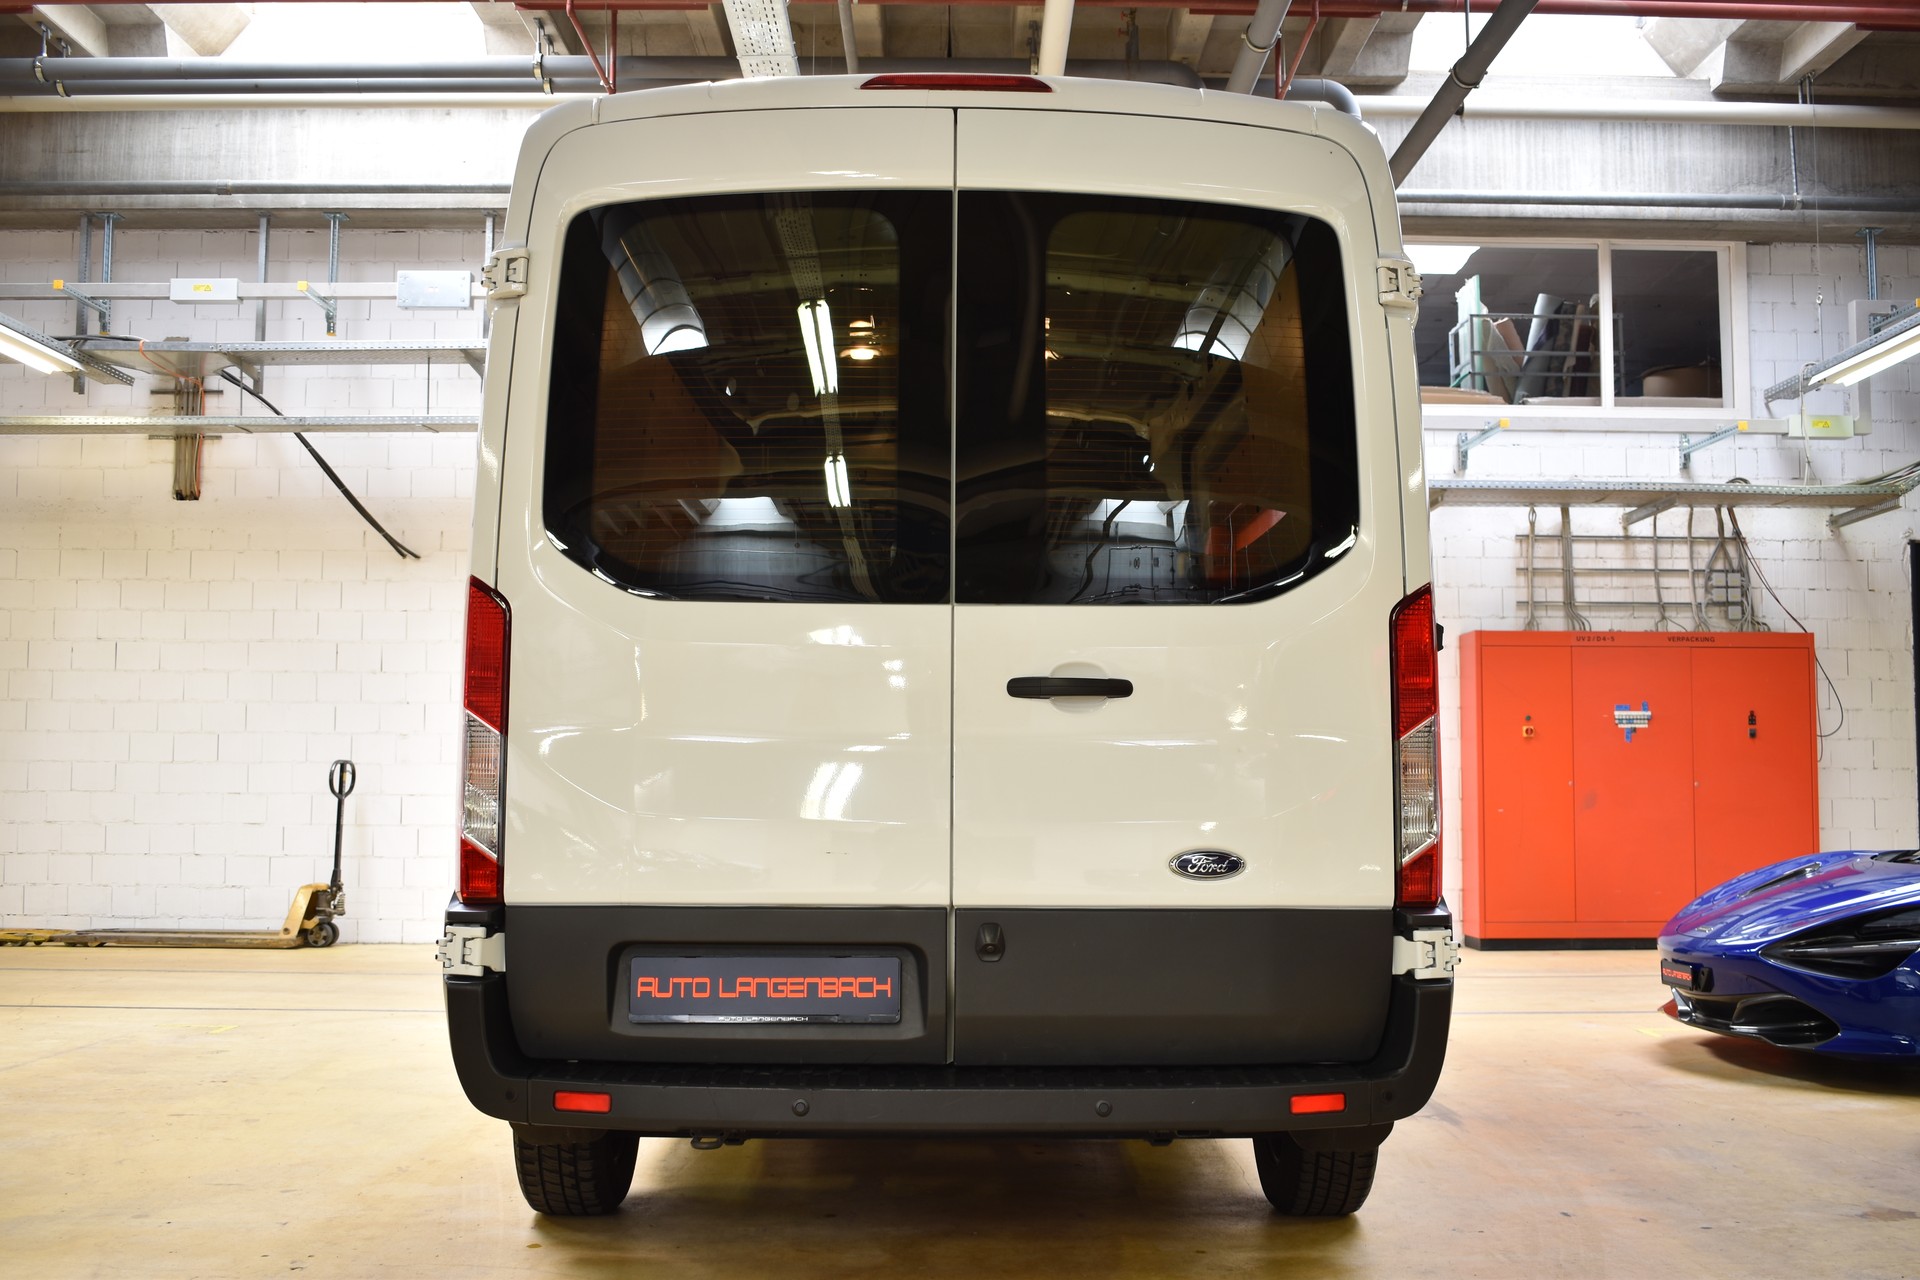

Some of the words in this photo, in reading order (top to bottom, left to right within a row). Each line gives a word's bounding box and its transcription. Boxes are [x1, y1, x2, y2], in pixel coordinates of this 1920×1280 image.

[1187, 855, 1229, 873] Ford
[637, 976, 710, 998] AUTO
[719, 976, 892, 998] LANGENBACH
